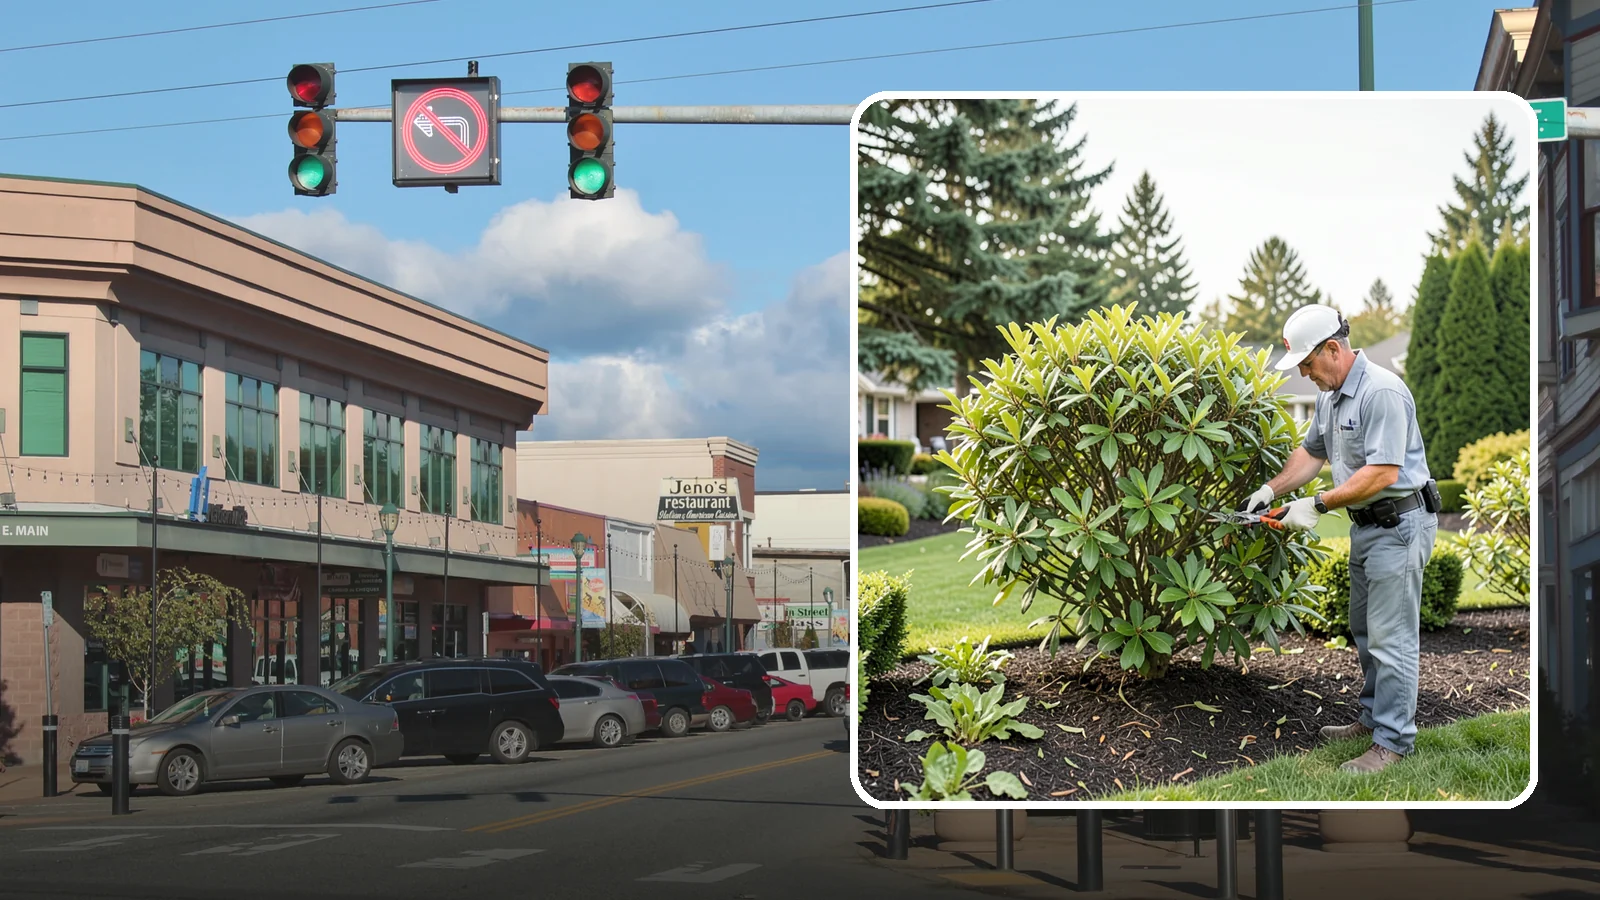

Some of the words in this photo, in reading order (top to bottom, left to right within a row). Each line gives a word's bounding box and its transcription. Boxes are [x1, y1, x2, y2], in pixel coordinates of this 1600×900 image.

[670, 480, 727, 494] Jeno's
[665, 497, 731, 509] restaurant
[658, 509, 681, 519] Italian
[686, 509, 714, 519] American
[715, 509, 738, 520] Cuisine
[2, 525, 13, 536] E.
[15, 525, 49, 536] MAIN
[797, 608, 828, 617] Street
[791, 619, 824, 627] lass
